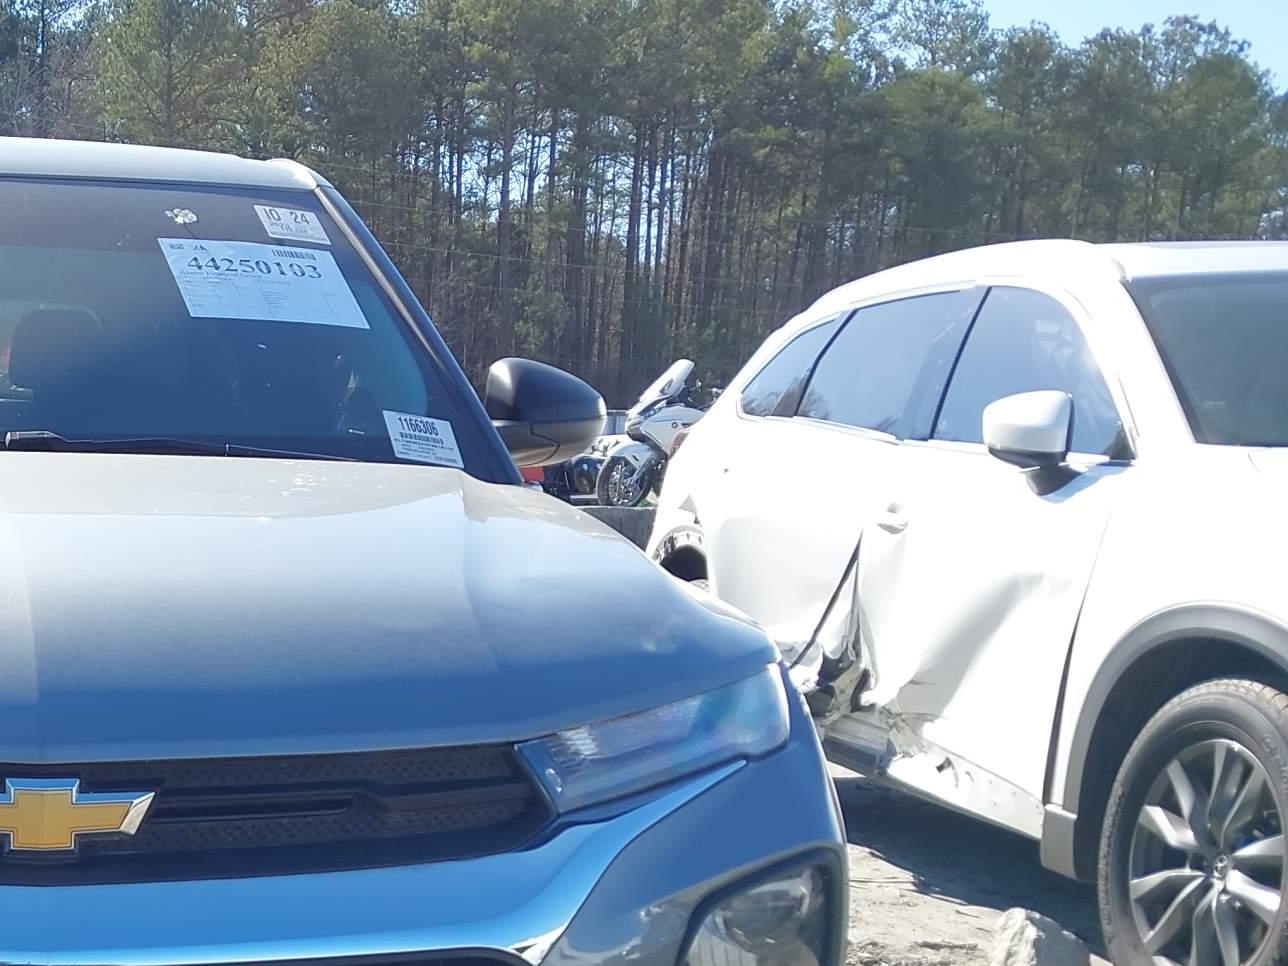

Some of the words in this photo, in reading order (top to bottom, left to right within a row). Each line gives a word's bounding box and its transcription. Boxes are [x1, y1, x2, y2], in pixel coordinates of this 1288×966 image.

[262, 207, 282, 221] 10
[289, 211, 310, 225] 24
[187, 256, 322, 279] 44250103
[398, 416, 439, 436] 1166306
